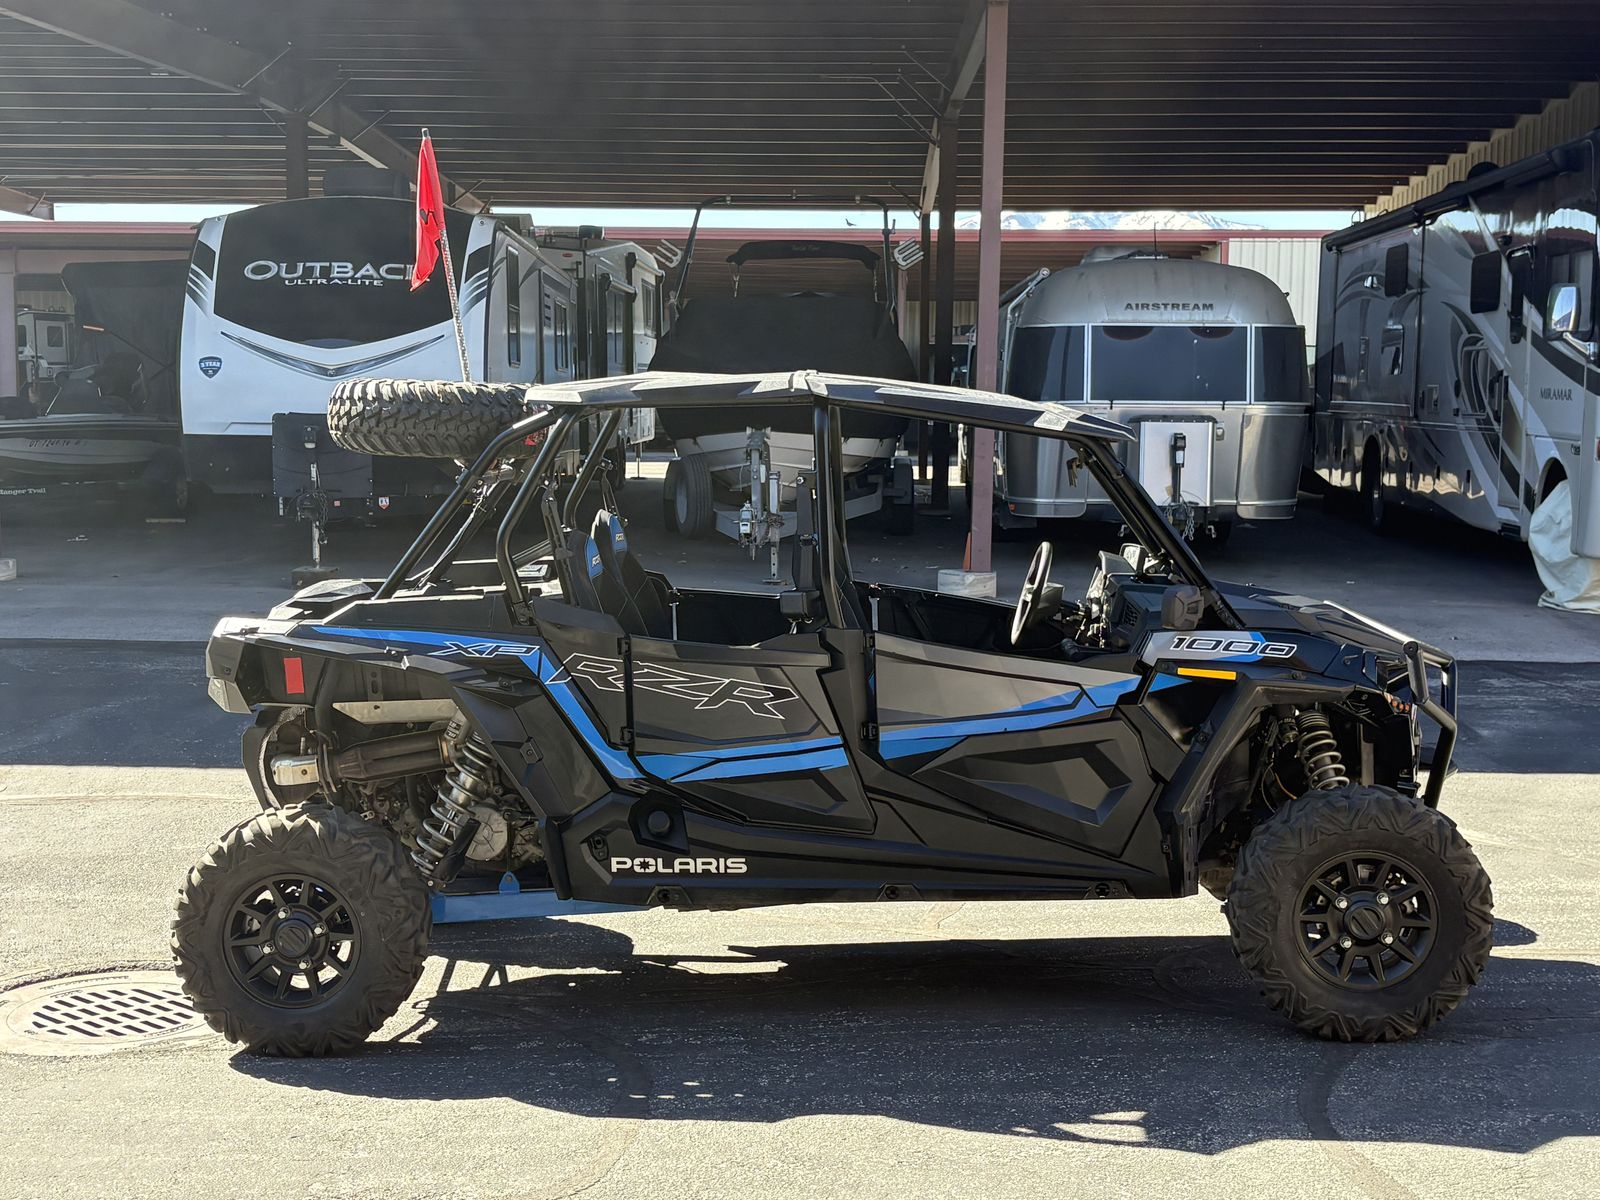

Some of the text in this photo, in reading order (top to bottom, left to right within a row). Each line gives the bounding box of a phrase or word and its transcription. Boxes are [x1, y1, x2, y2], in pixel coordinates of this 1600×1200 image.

[285, 278, 383, 287] ULTRA-LITE
[1124, 302, 1215, 312] AIRSTREAM
[1540, 387, 1573, 401] MIRAMAR
[429, 640, 541, 658] XP
[1170, 635, 1297, 659] 1000
[545, 652, 799, 719] RZR
[610, 856, 748, 875] POLARIS
